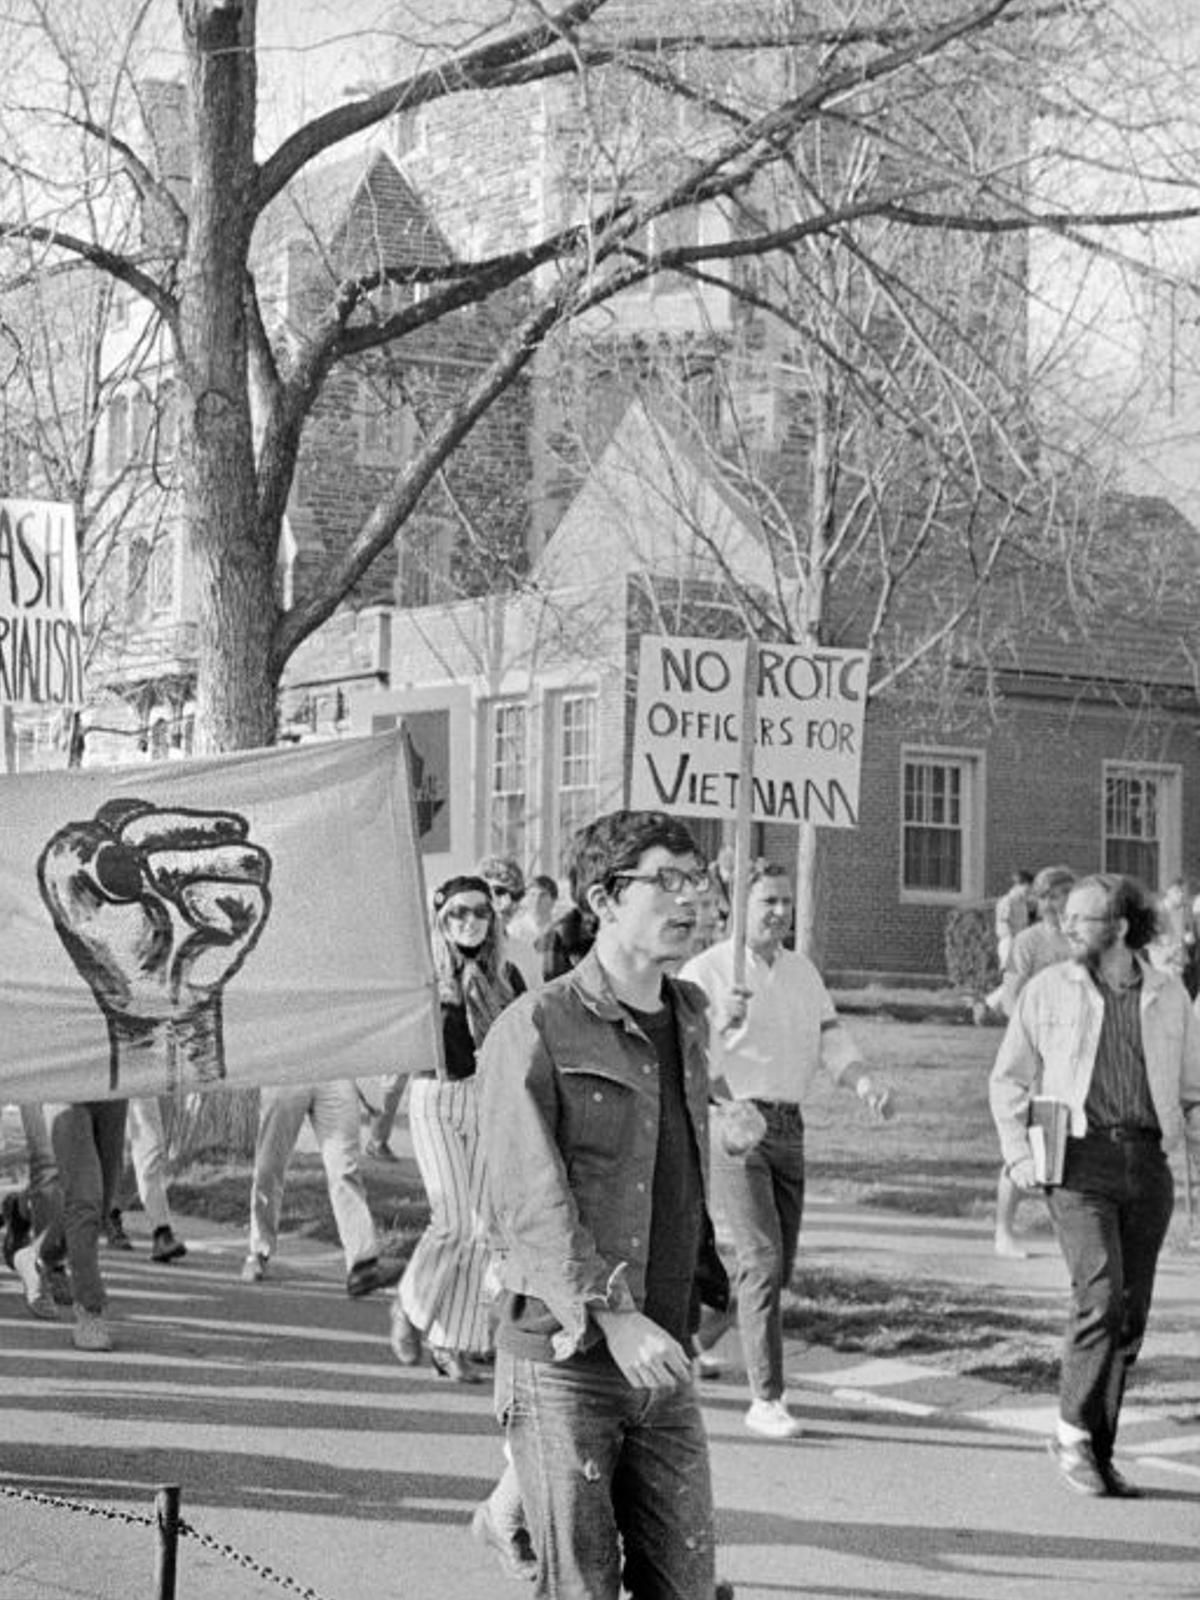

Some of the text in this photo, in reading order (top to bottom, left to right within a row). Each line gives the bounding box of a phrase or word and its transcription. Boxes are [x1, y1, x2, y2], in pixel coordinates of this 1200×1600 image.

[661, 646, 864, 702] NO ROTC
[648, 702, 855, 754] OFFICRS FOR
